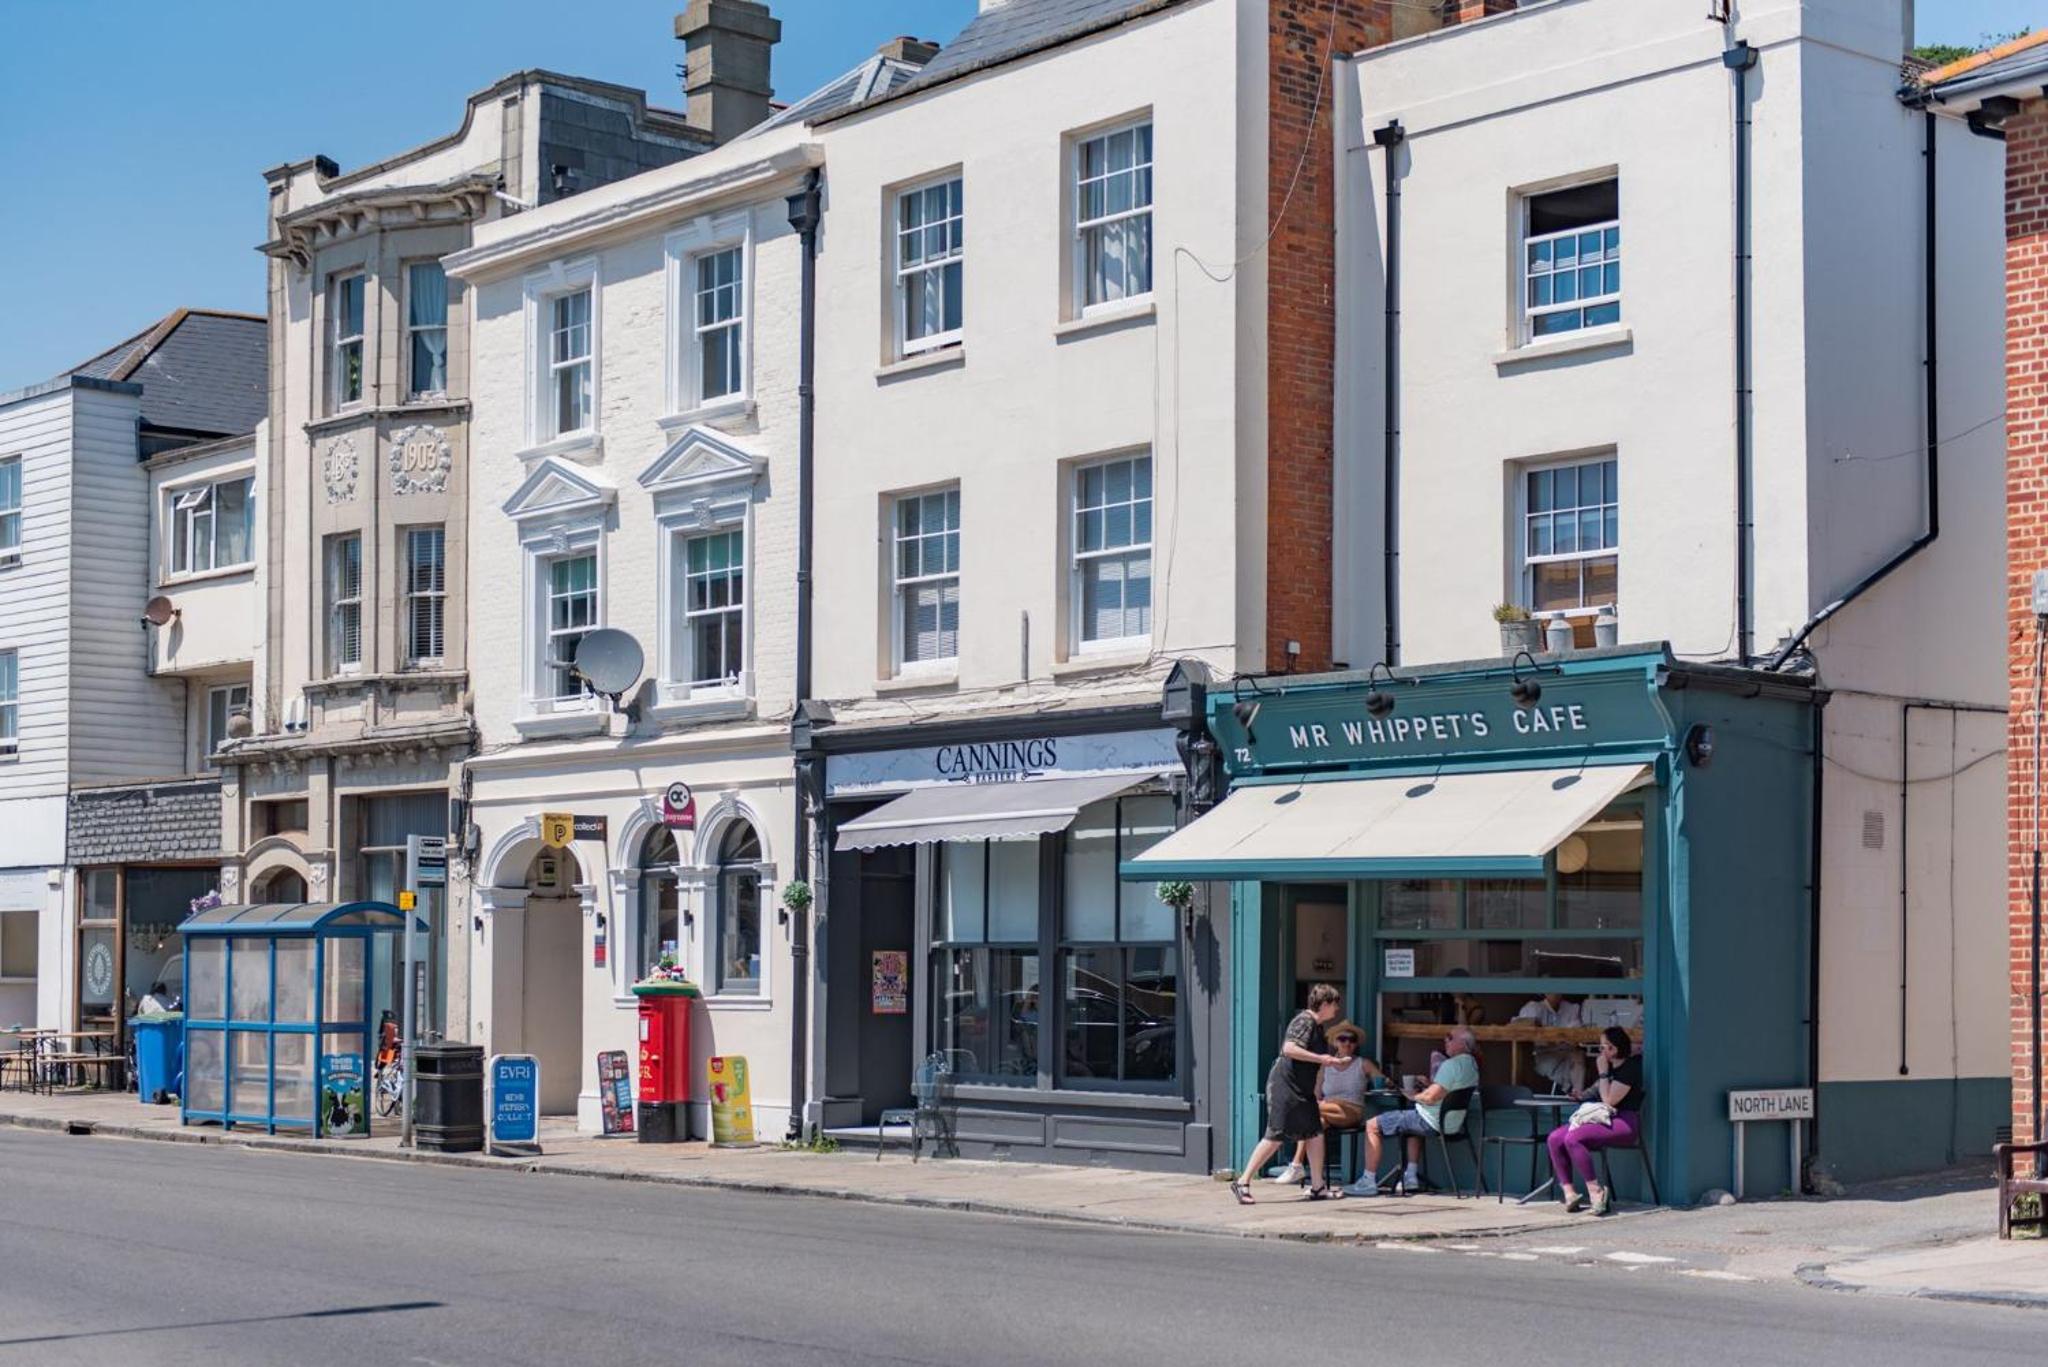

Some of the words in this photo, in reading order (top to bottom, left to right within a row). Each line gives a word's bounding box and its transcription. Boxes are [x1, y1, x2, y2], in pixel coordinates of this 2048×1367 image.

[403, 441, 438, 472] 1903
[1290, 722, 1330, 748] MR
[1341, 711, 1489, 745] WHIPPET'S
[1513, 704, 1588, 735] CAFE
[936, 737, 1058, 774] CANNINGS
[1233, 747, 1252, 763] 72
[1734, 1096, 1776, 1113] NORTH
[1778, 1095, 1809, 1112] LANE
